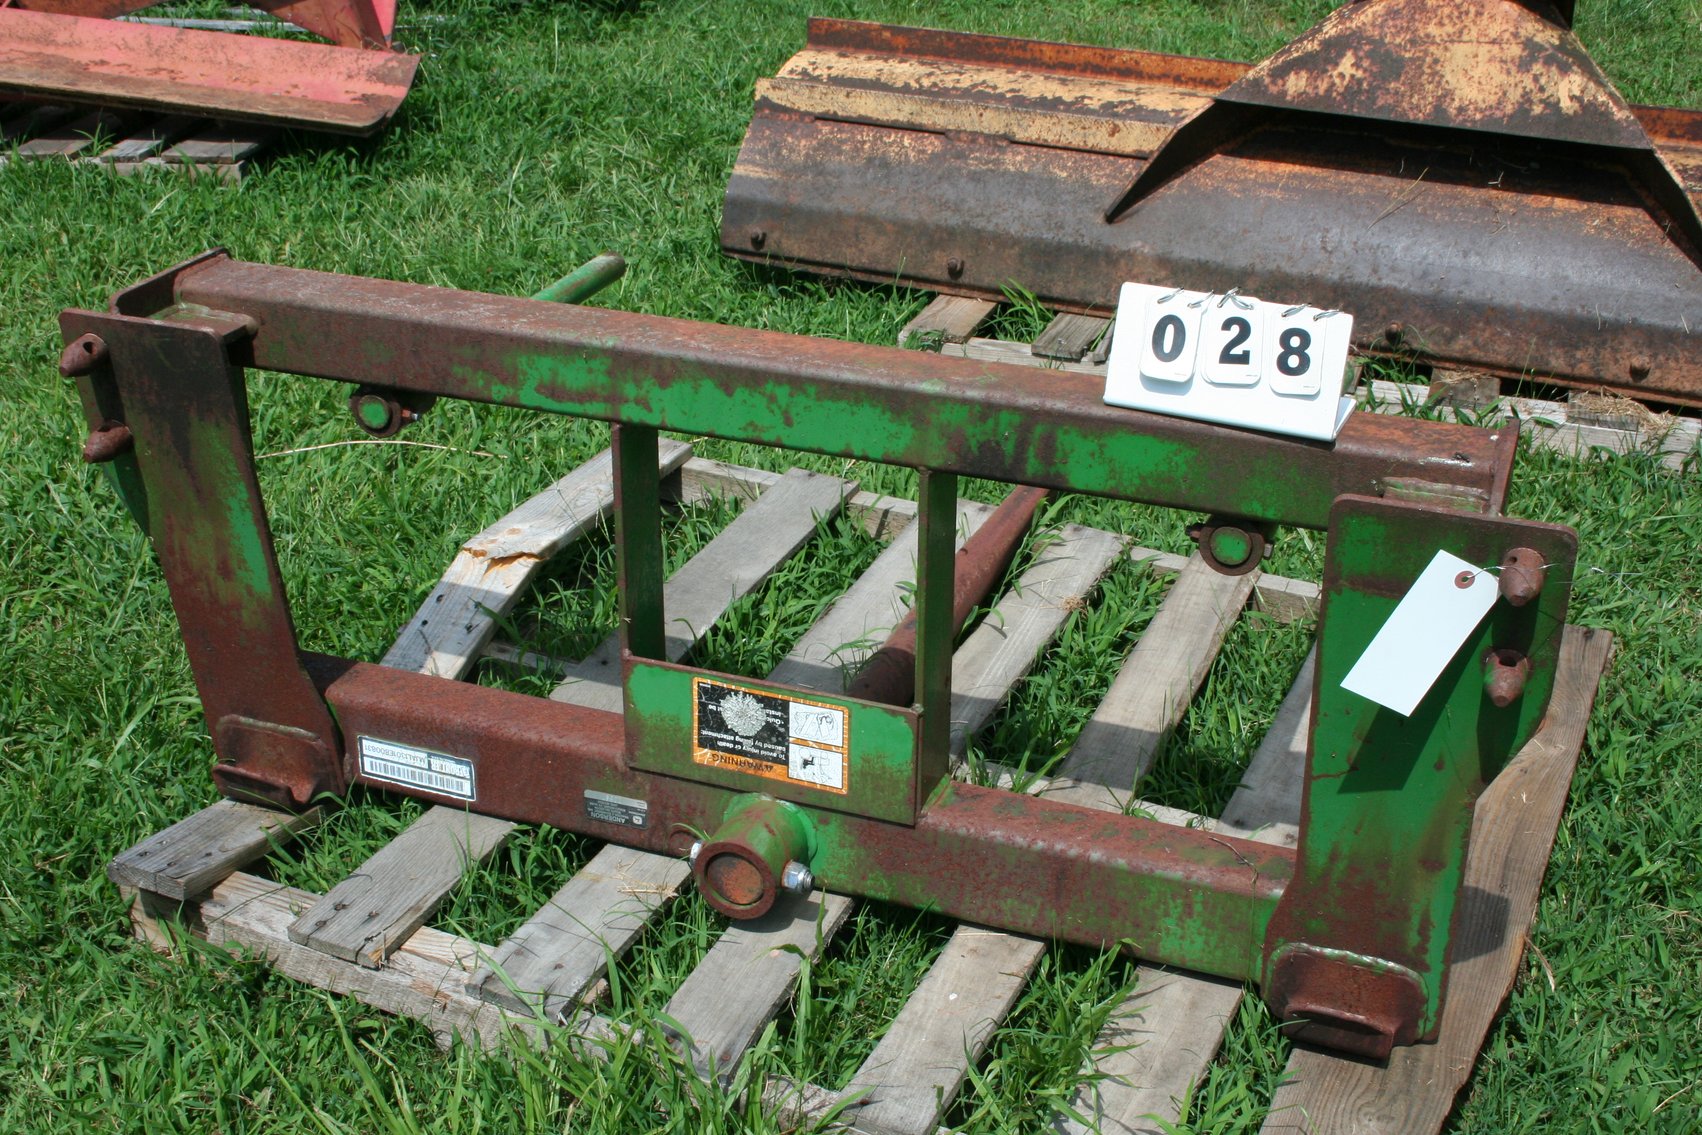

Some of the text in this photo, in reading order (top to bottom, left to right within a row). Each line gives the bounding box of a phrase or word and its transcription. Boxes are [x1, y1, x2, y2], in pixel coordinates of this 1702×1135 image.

[717, 741, 734, 749] death
[755, 739, 762, 747] by
[764, 742, 786, 751] caused
[743, 745, 759, 754] injury
[760, 750, 777, 758] avoid
[711, 753, 765, 771] WARNING
